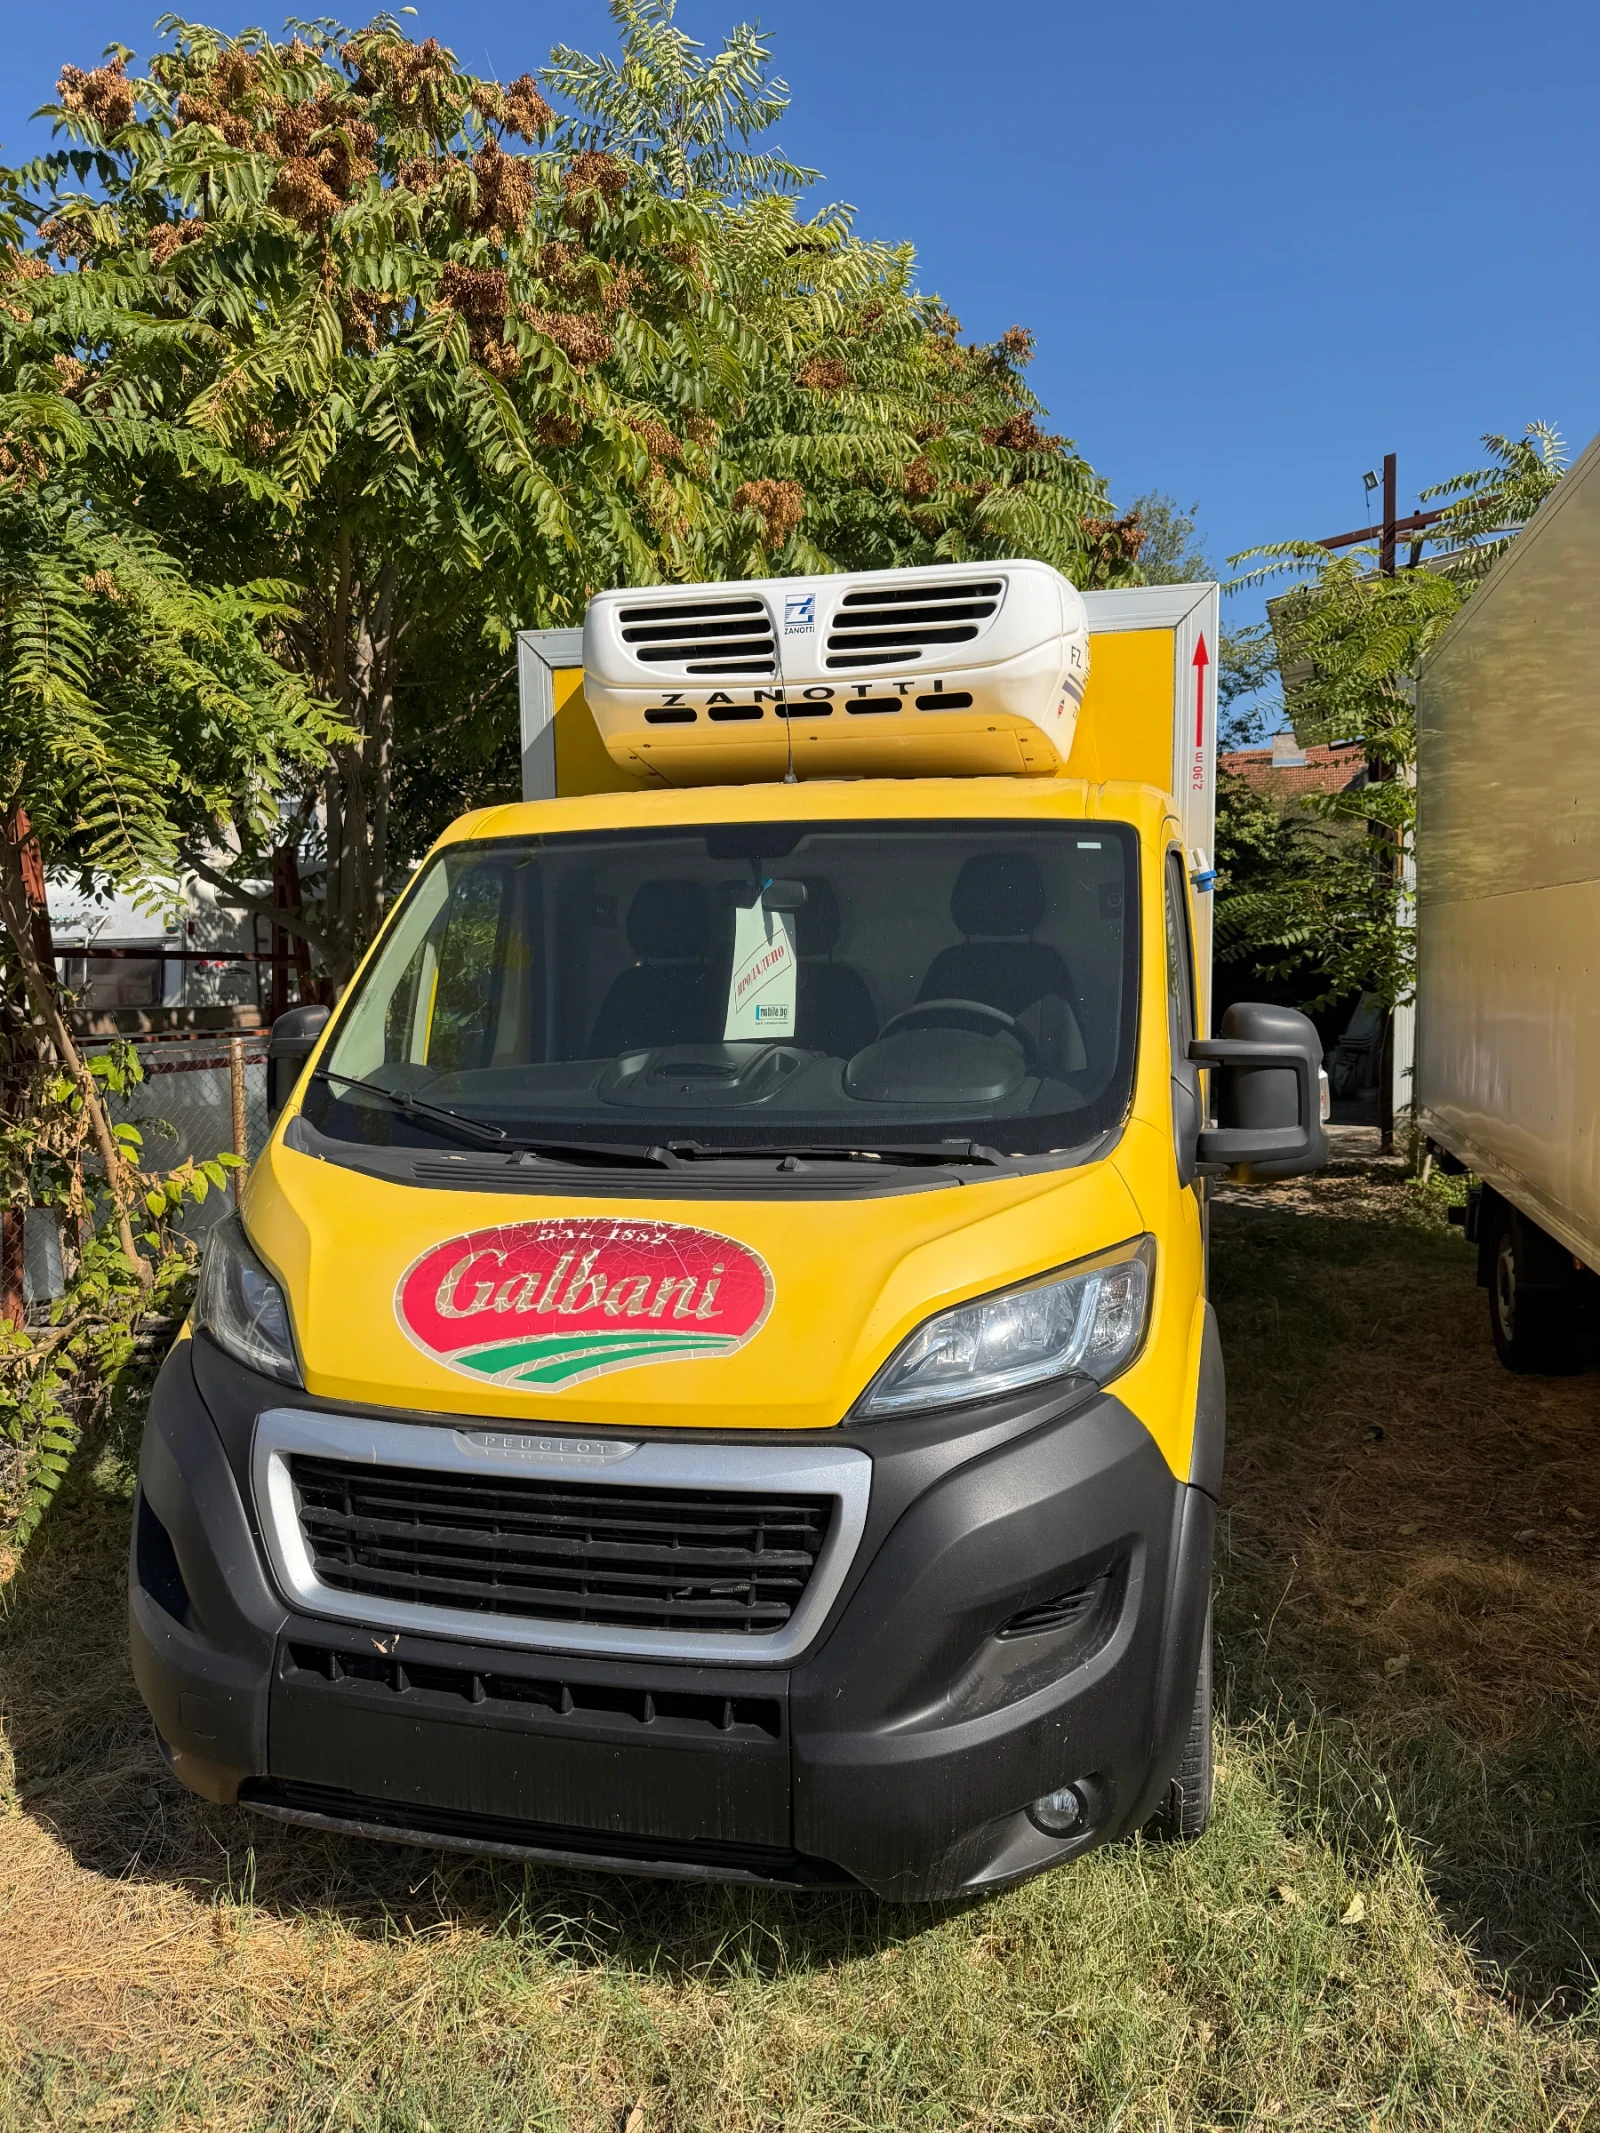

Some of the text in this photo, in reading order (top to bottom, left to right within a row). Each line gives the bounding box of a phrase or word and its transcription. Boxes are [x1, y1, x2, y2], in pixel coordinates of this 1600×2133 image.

[784, 626, 815, 635] ZANOTTI
[661, 679, 944, 707] ZANOTTI
[1192, 751, 1204, 790] 2,90 m
[737, 945, 785, 997] ПРОДАДЕНО
[760, 1006, 788, 1018] mobile.bg
[608, 1228, 668, 1245] 1882
[434, 1247, 725, 1320] Galbani
[485, 1435, 609, 1454] PEUGEOT
